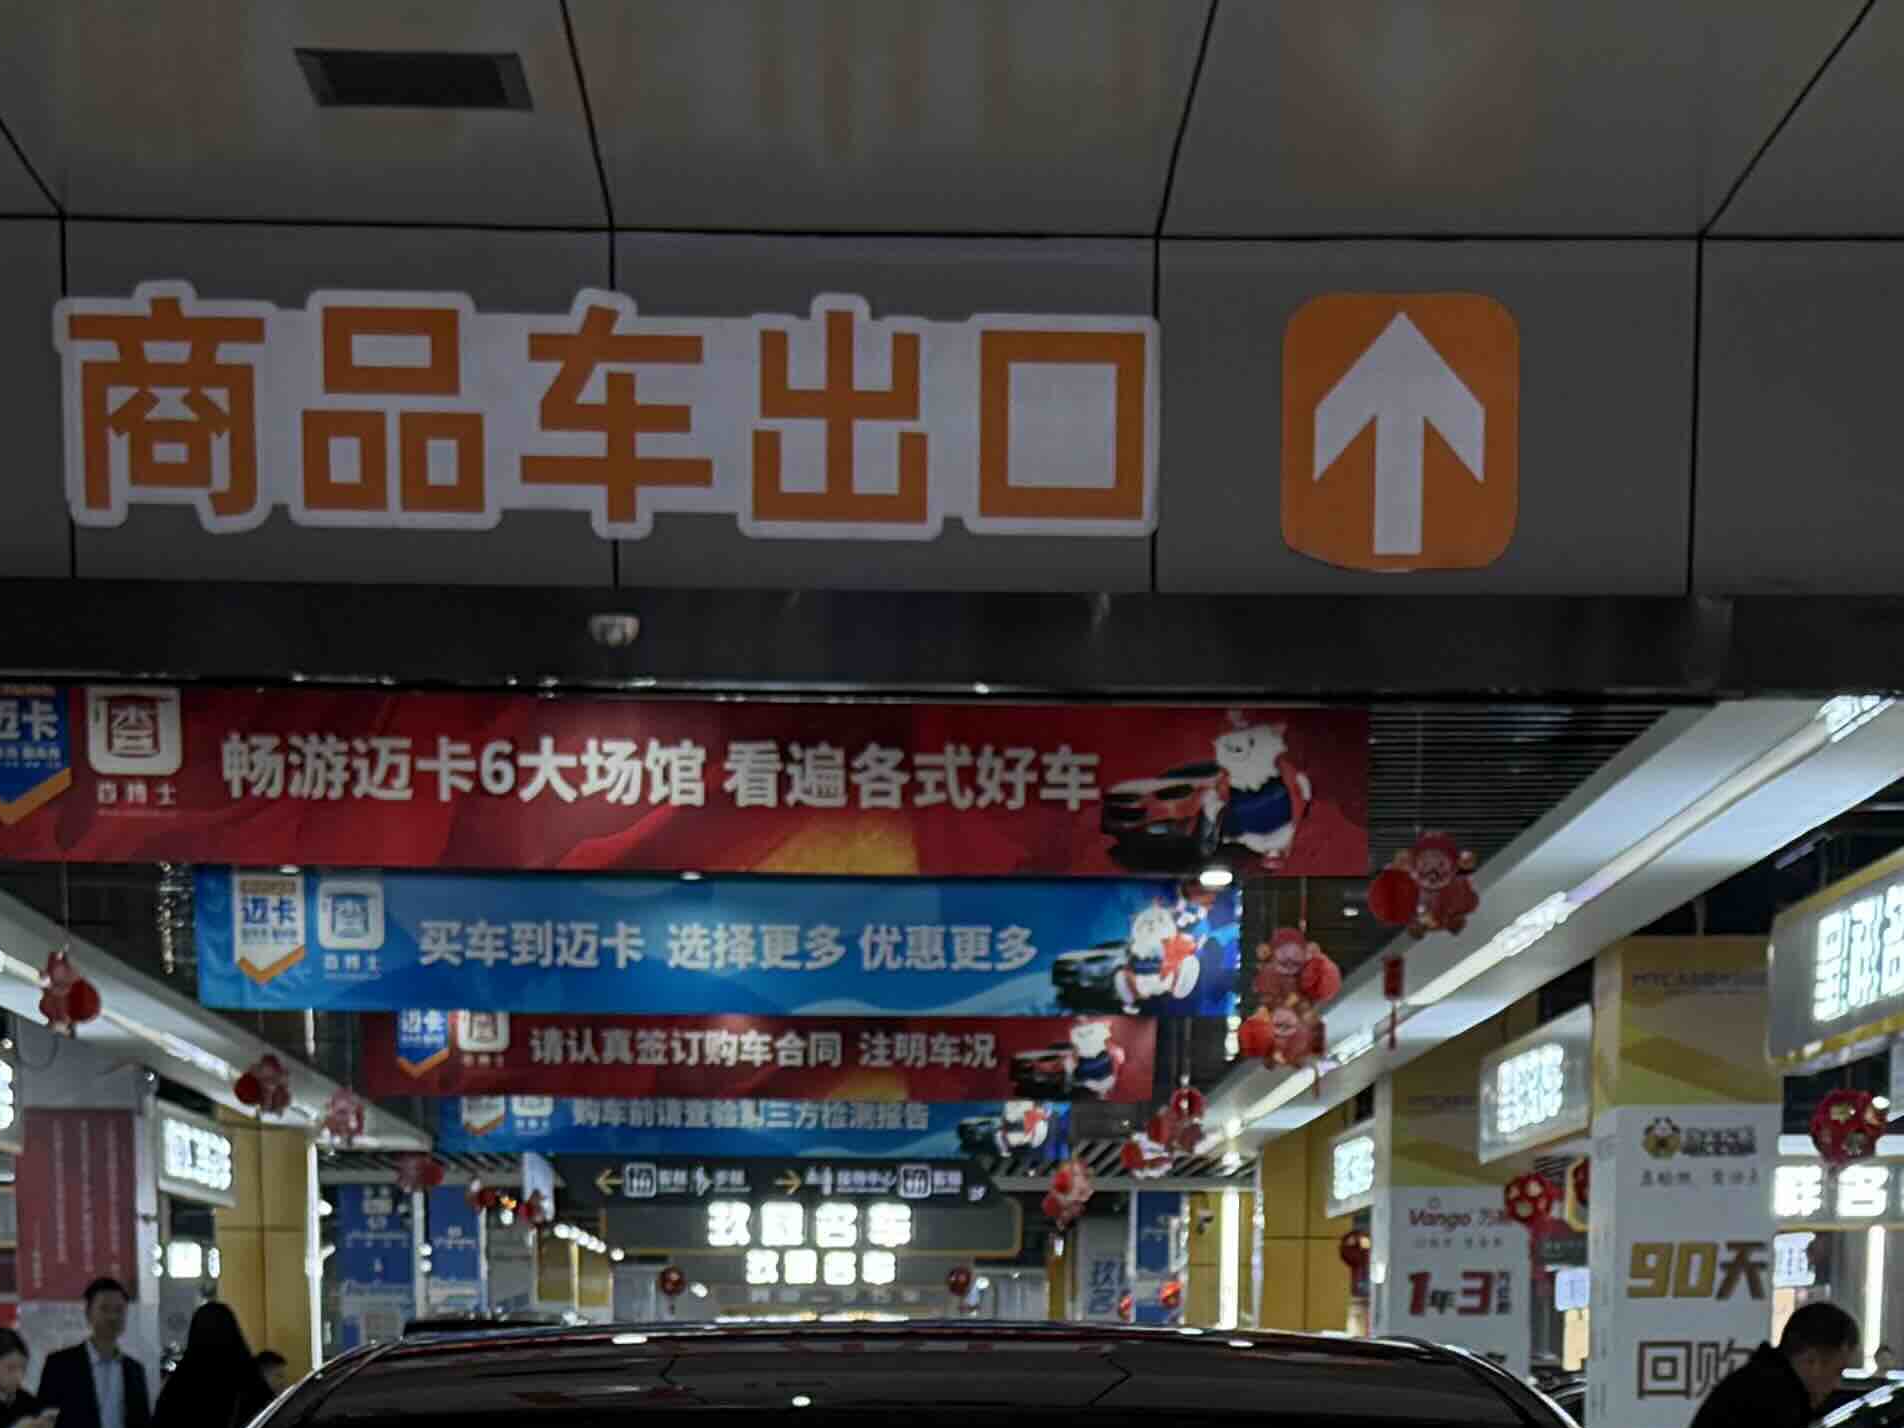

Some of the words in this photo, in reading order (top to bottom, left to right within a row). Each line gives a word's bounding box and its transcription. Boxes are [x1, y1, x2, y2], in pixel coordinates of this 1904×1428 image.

[69, 297, 1146, 525] 商品车出口
[223, 733, 706, 806] 畅游迈卡6大场馆
[723, 740, 1099, 812] 看遍各式好车
[418, 920, 645, 969] 买车到迈卡
[666, 923, 846, 972] 选择更多
[858, 924, 1038, 973] 优惠更多
[530, 1026, 844, 1068] 请认真签订购车合同
[859, 1029, 998, 1069] 注明车况
[1627, 1241, 1769, 1301] 90天
